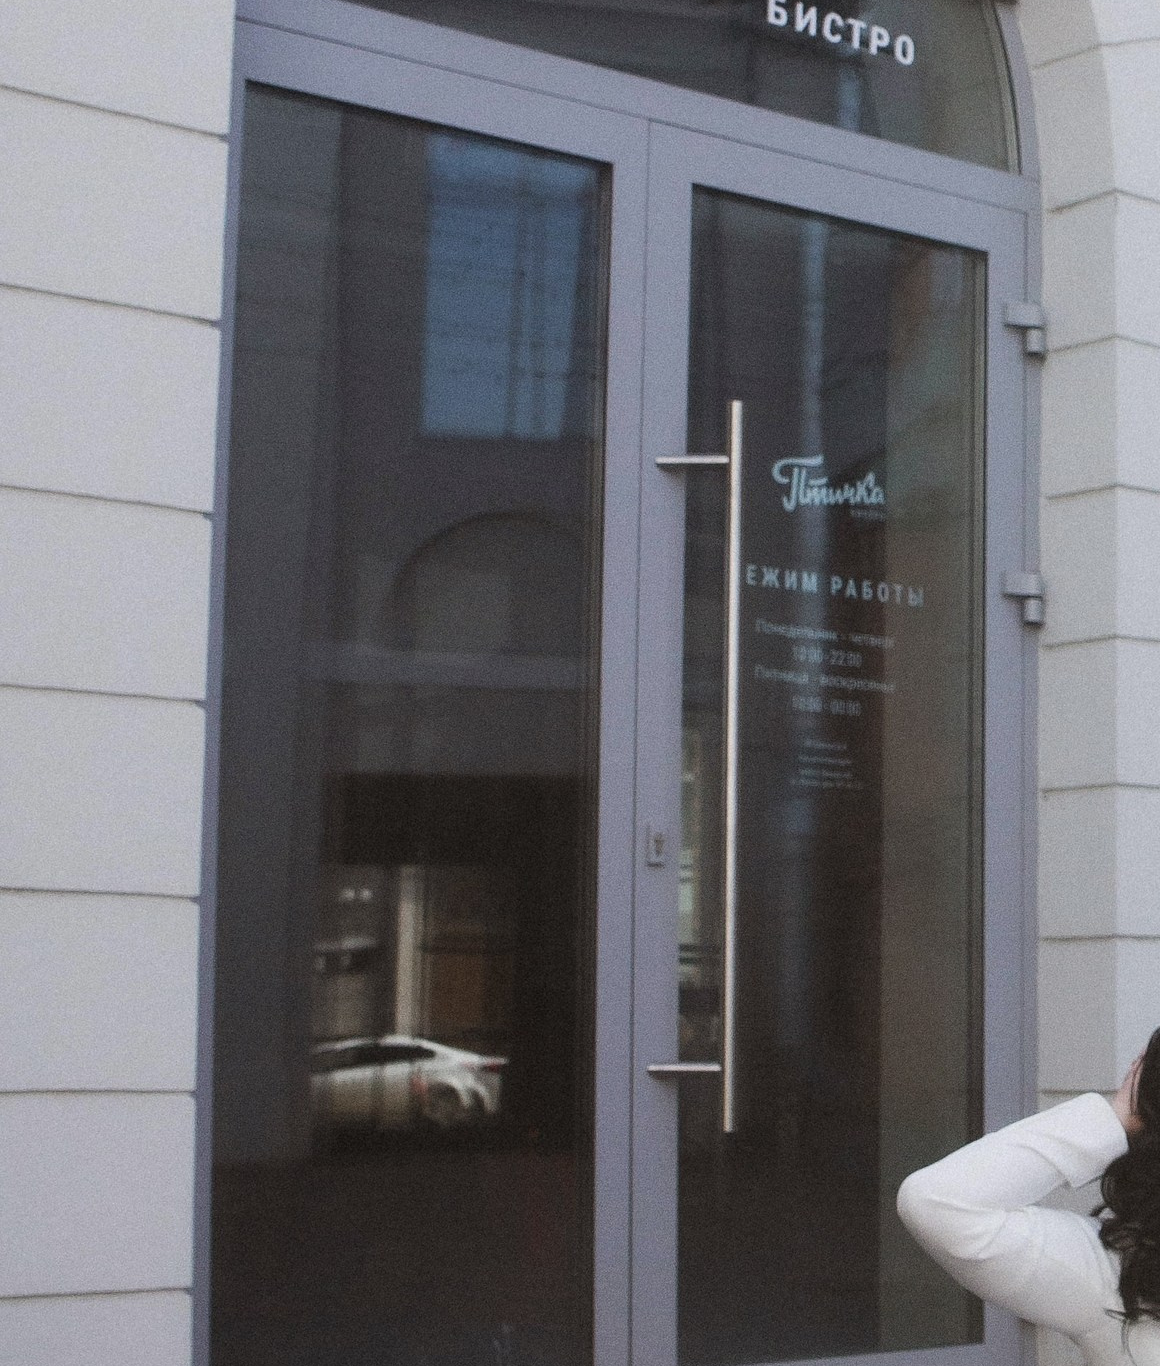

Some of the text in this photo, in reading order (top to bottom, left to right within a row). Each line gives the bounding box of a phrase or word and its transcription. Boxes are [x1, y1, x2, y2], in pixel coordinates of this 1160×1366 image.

[771, 454, 886, 513] Птичка
[745, 563, 925, 608] ЕЖИМ РАБОТЫ
